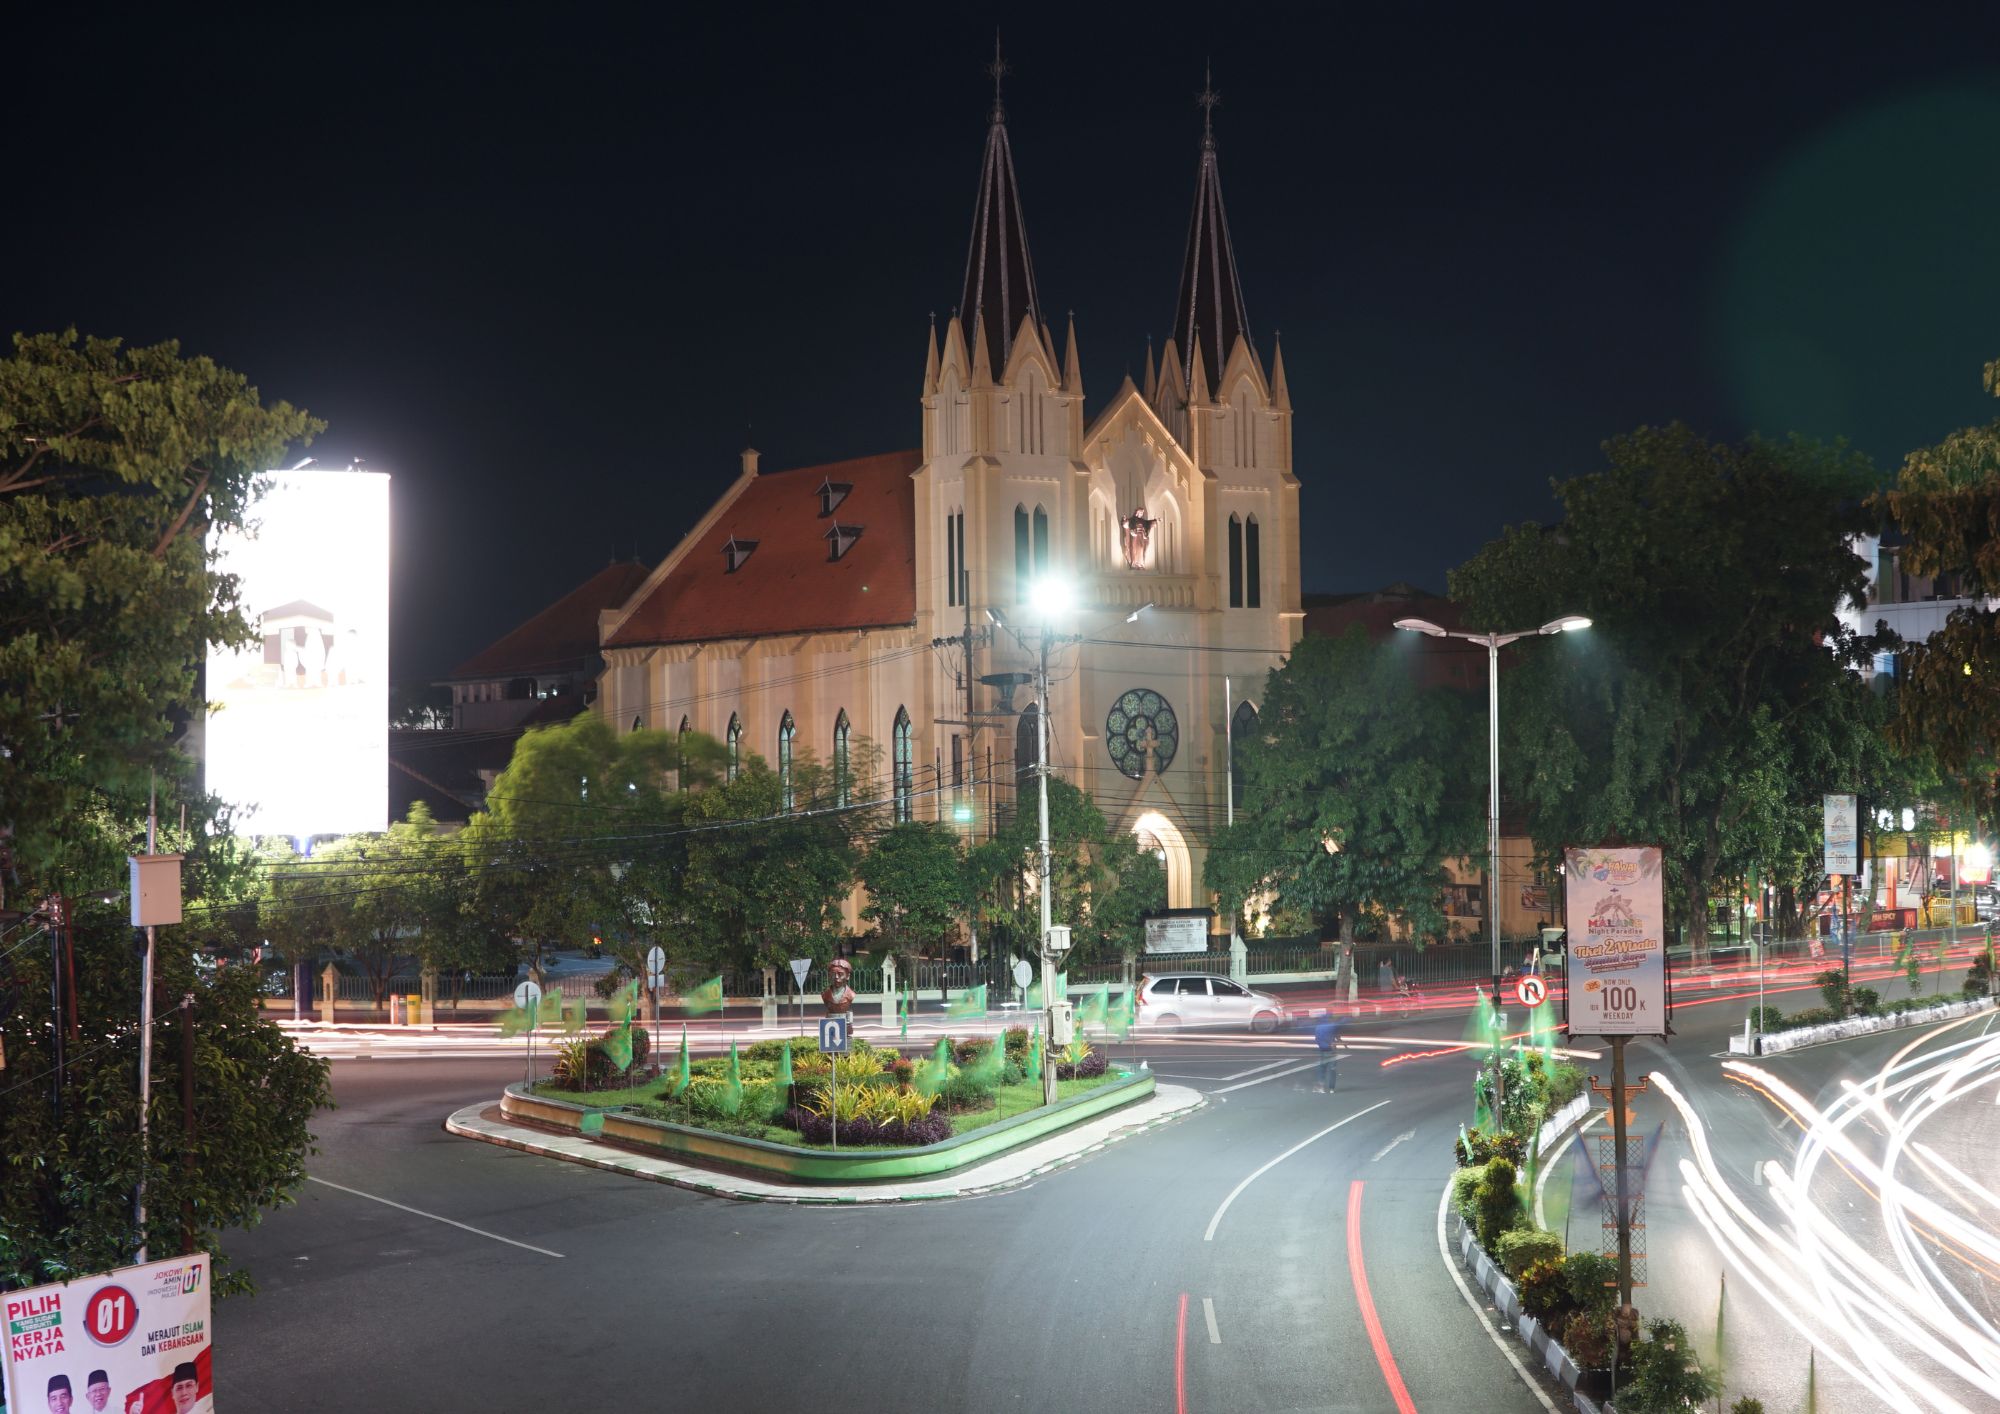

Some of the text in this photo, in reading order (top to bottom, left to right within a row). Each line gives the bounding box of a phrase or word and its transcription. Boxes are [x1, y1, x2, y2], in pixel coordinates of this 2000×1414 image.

[1588, 919, 1643, 927] MALANG
[1604, 938, 1615, 955] 2
[1615, 939, 1657, 953] Wisata
[1600, 987, 1636, 1011] 100
[1640, 1000, 1646, 1011] K
[1603, 1012, 1634, 1020] WEEKDAY
[154, 1268, 182, 1280] JOKOWI
[163, 1276, 181, 1284] AMIN
[8, 1294, 61, 1320] PILIH
[97, 1296, 125, 1335] 01
[12, 1327, 64, 1348] KERJA
[148, 1320, 203, 1342] MERAJUT ISLAM
[14, 1340, 65, 1362] NYATA
[141, 1332, 204, 1356] DAN KEBANGSAAN
